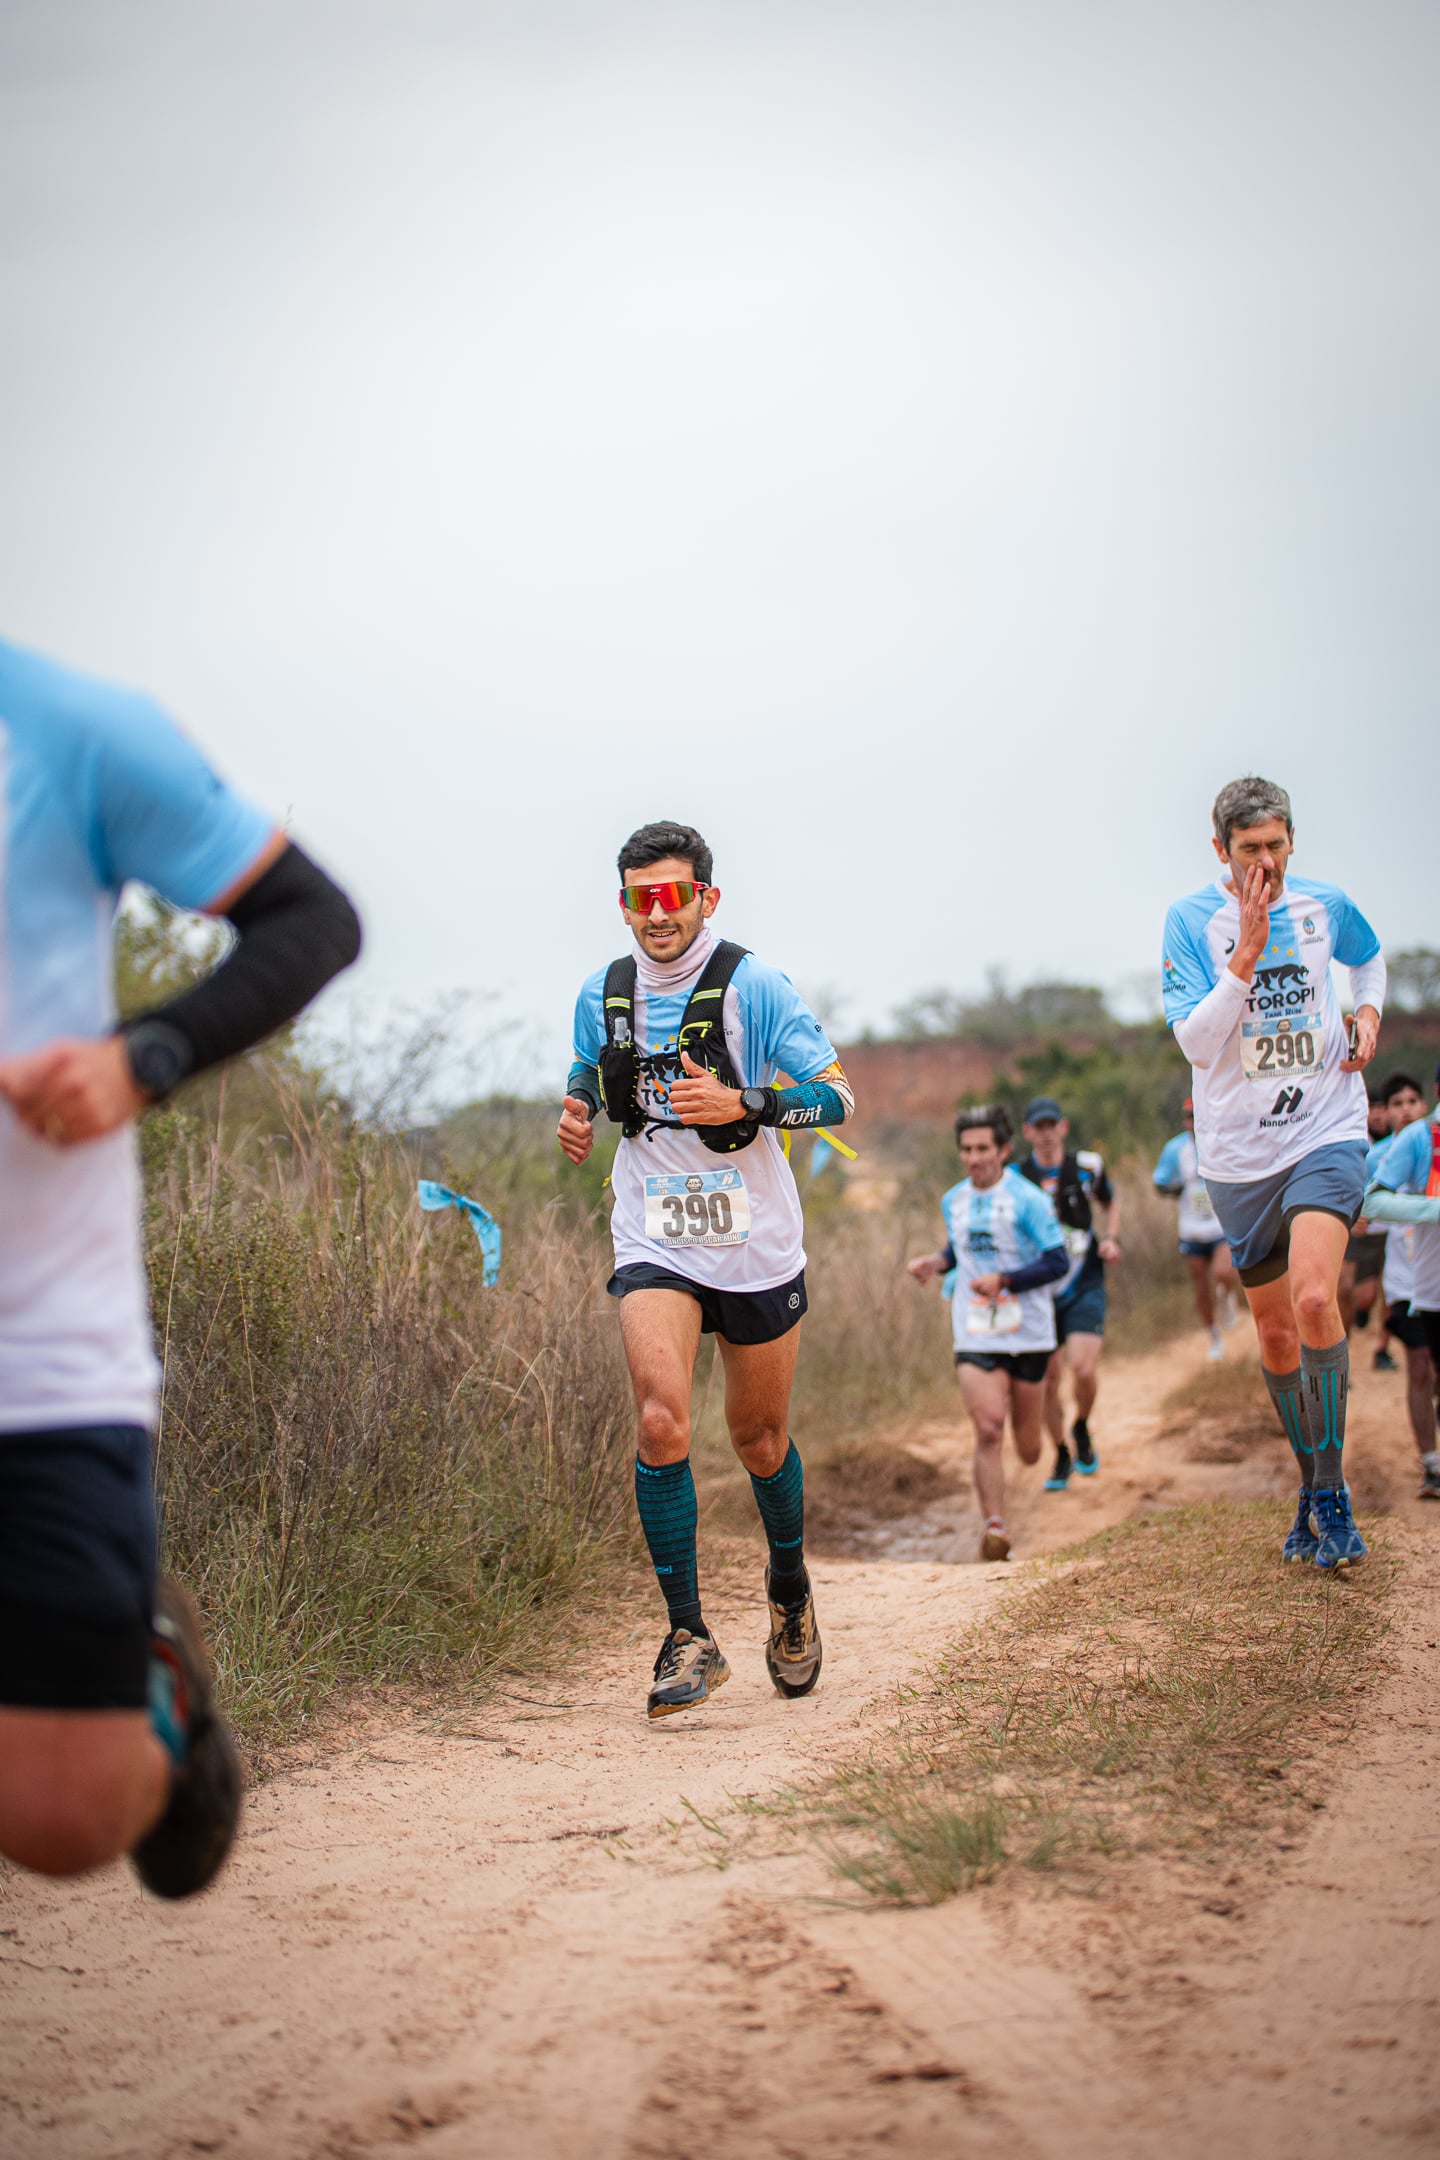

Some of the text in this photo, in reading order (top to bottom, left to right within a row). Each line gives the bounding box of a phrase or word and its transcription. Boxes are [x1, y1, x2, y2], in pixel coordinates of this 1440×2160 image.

[1245, 986, 1315, 1013] TOROPI
[1255, 1031, 1315, 1071] 290
[662, 1192, 733, 1238] 390
[699, 1234, 722, 1244] OSCAR
